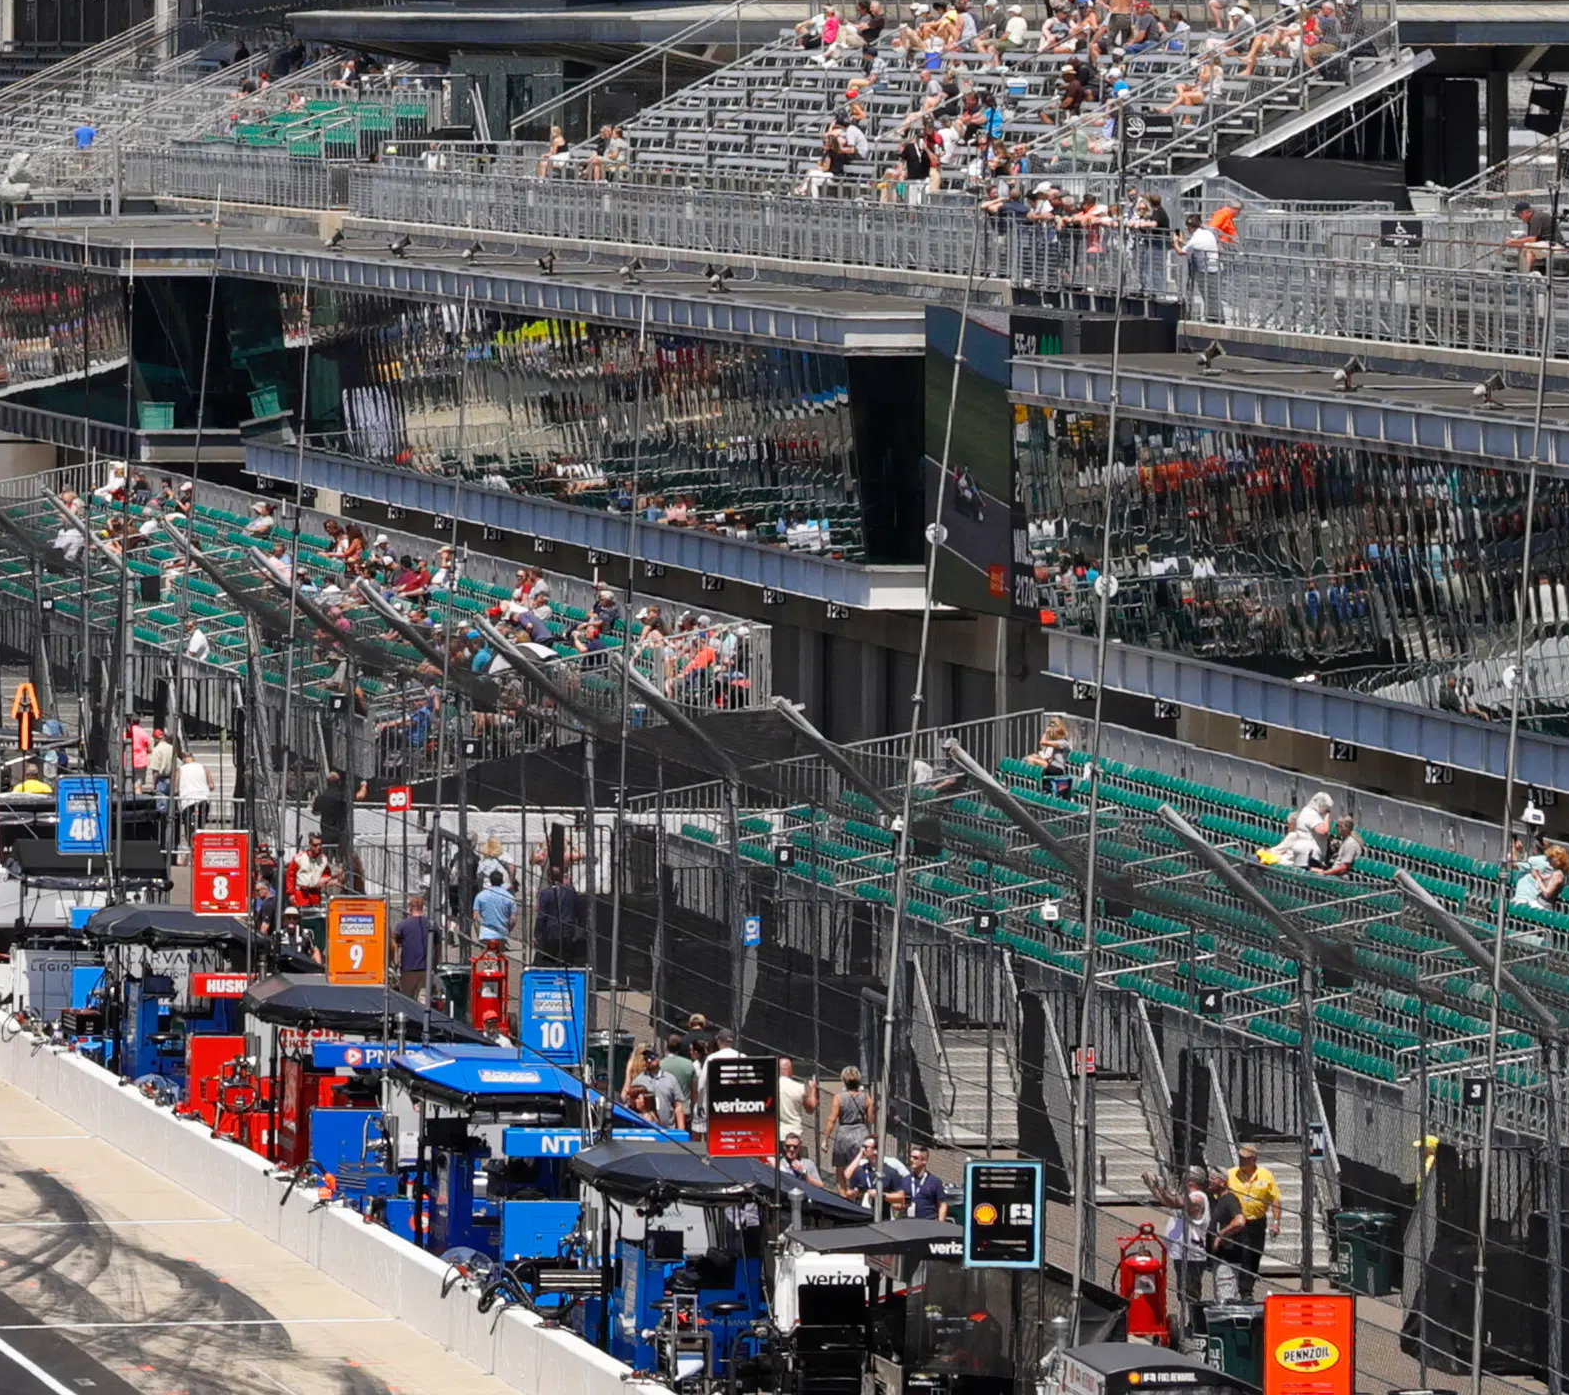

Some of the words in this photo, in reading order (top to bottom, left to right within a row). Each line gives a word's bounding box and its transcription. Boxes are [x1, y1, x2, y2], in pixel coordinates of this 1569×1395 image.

[68, 818, 97, 841] 48
[212, 876, 228, 900] 8
[348, 944, 364, 970] 9
[30, 962, 73, 972] LEGIO
[540, 1021, 565, 1049] 10
[1471, 1085, 1481, 1098] 3
[713, 1099, 765, 1113] verizon
[929, 1241, 963, 1255] veriz
[1283, 1346, 1330, 1362] PENNZOIL
